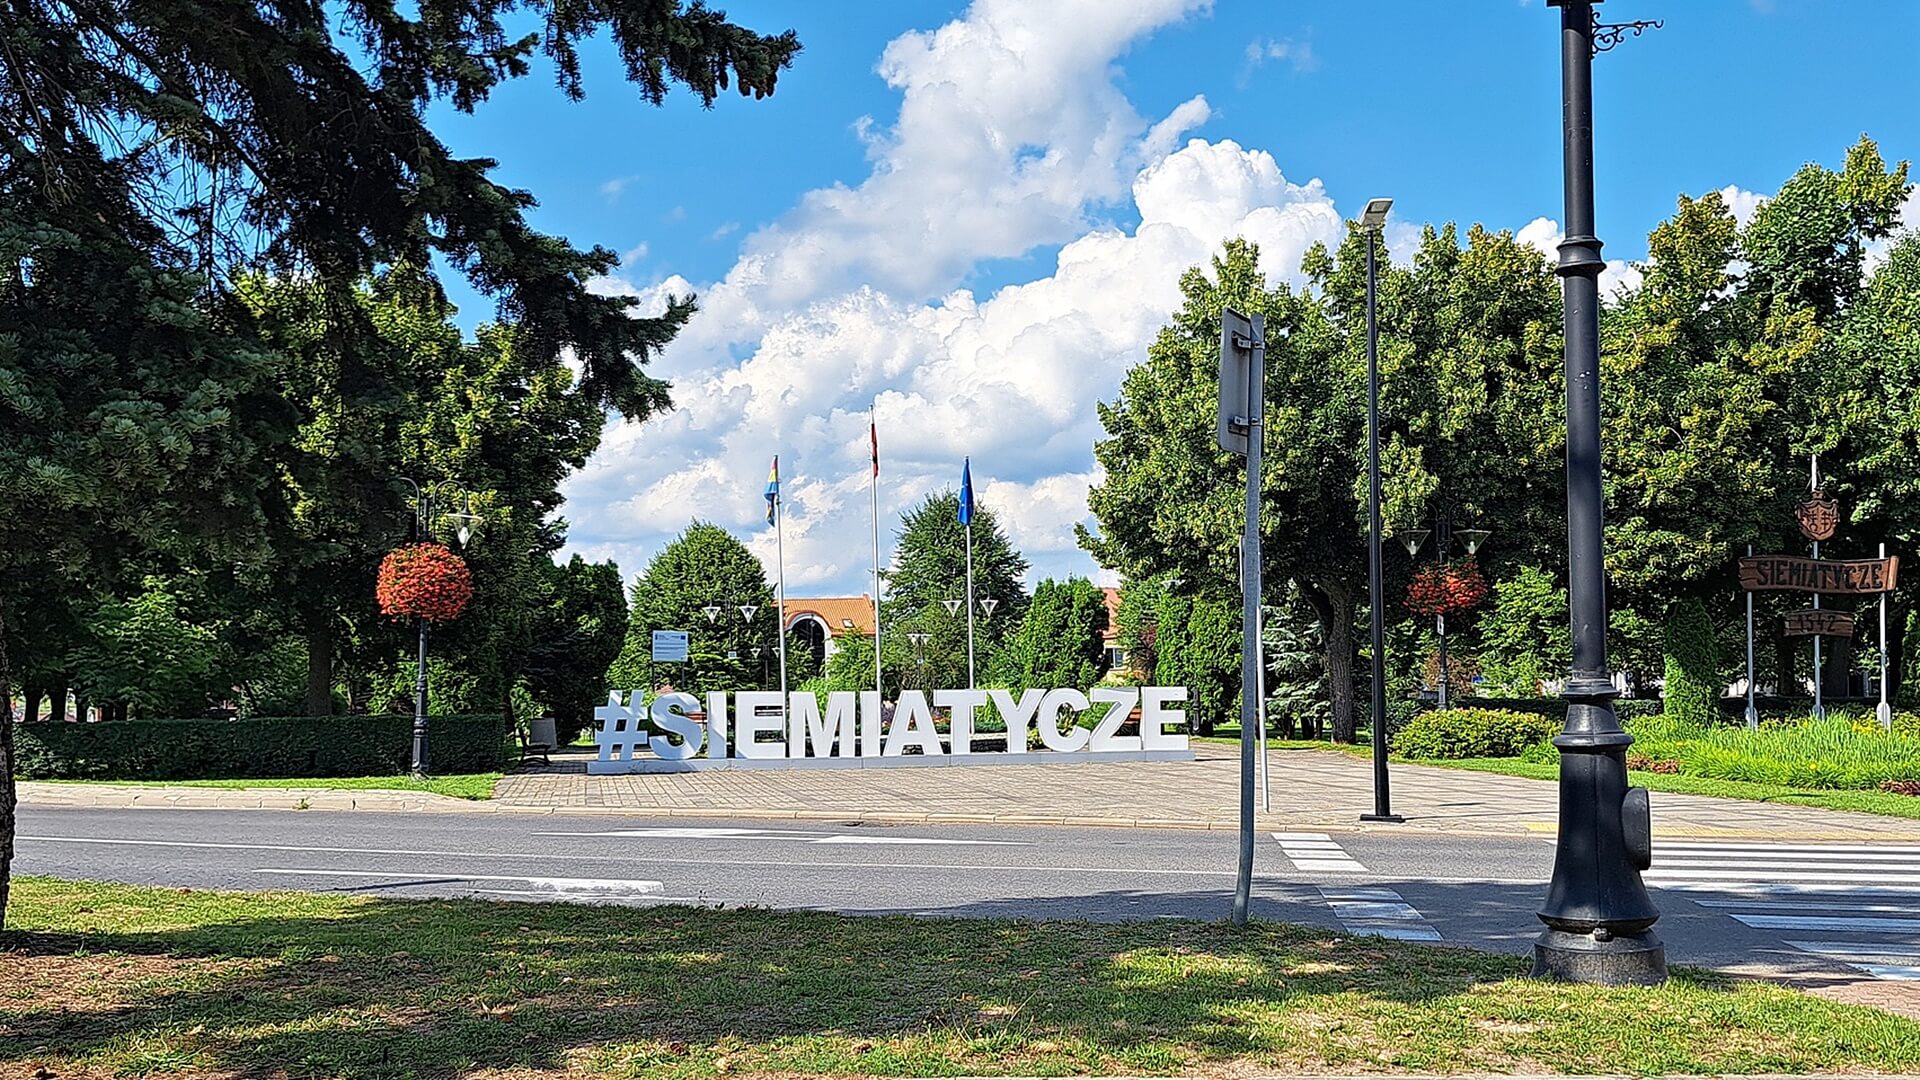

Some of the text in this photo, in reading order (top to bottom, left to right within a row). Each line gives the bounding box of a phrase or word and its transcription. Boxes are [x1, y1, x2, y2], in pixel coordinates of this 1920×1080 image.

[1756, 559, 1884, 590] SIEMIATYCZE
[1799, 614, 1836, 633] 1542
[594, 686, 1189, 762] #SIEMIATYCZE
